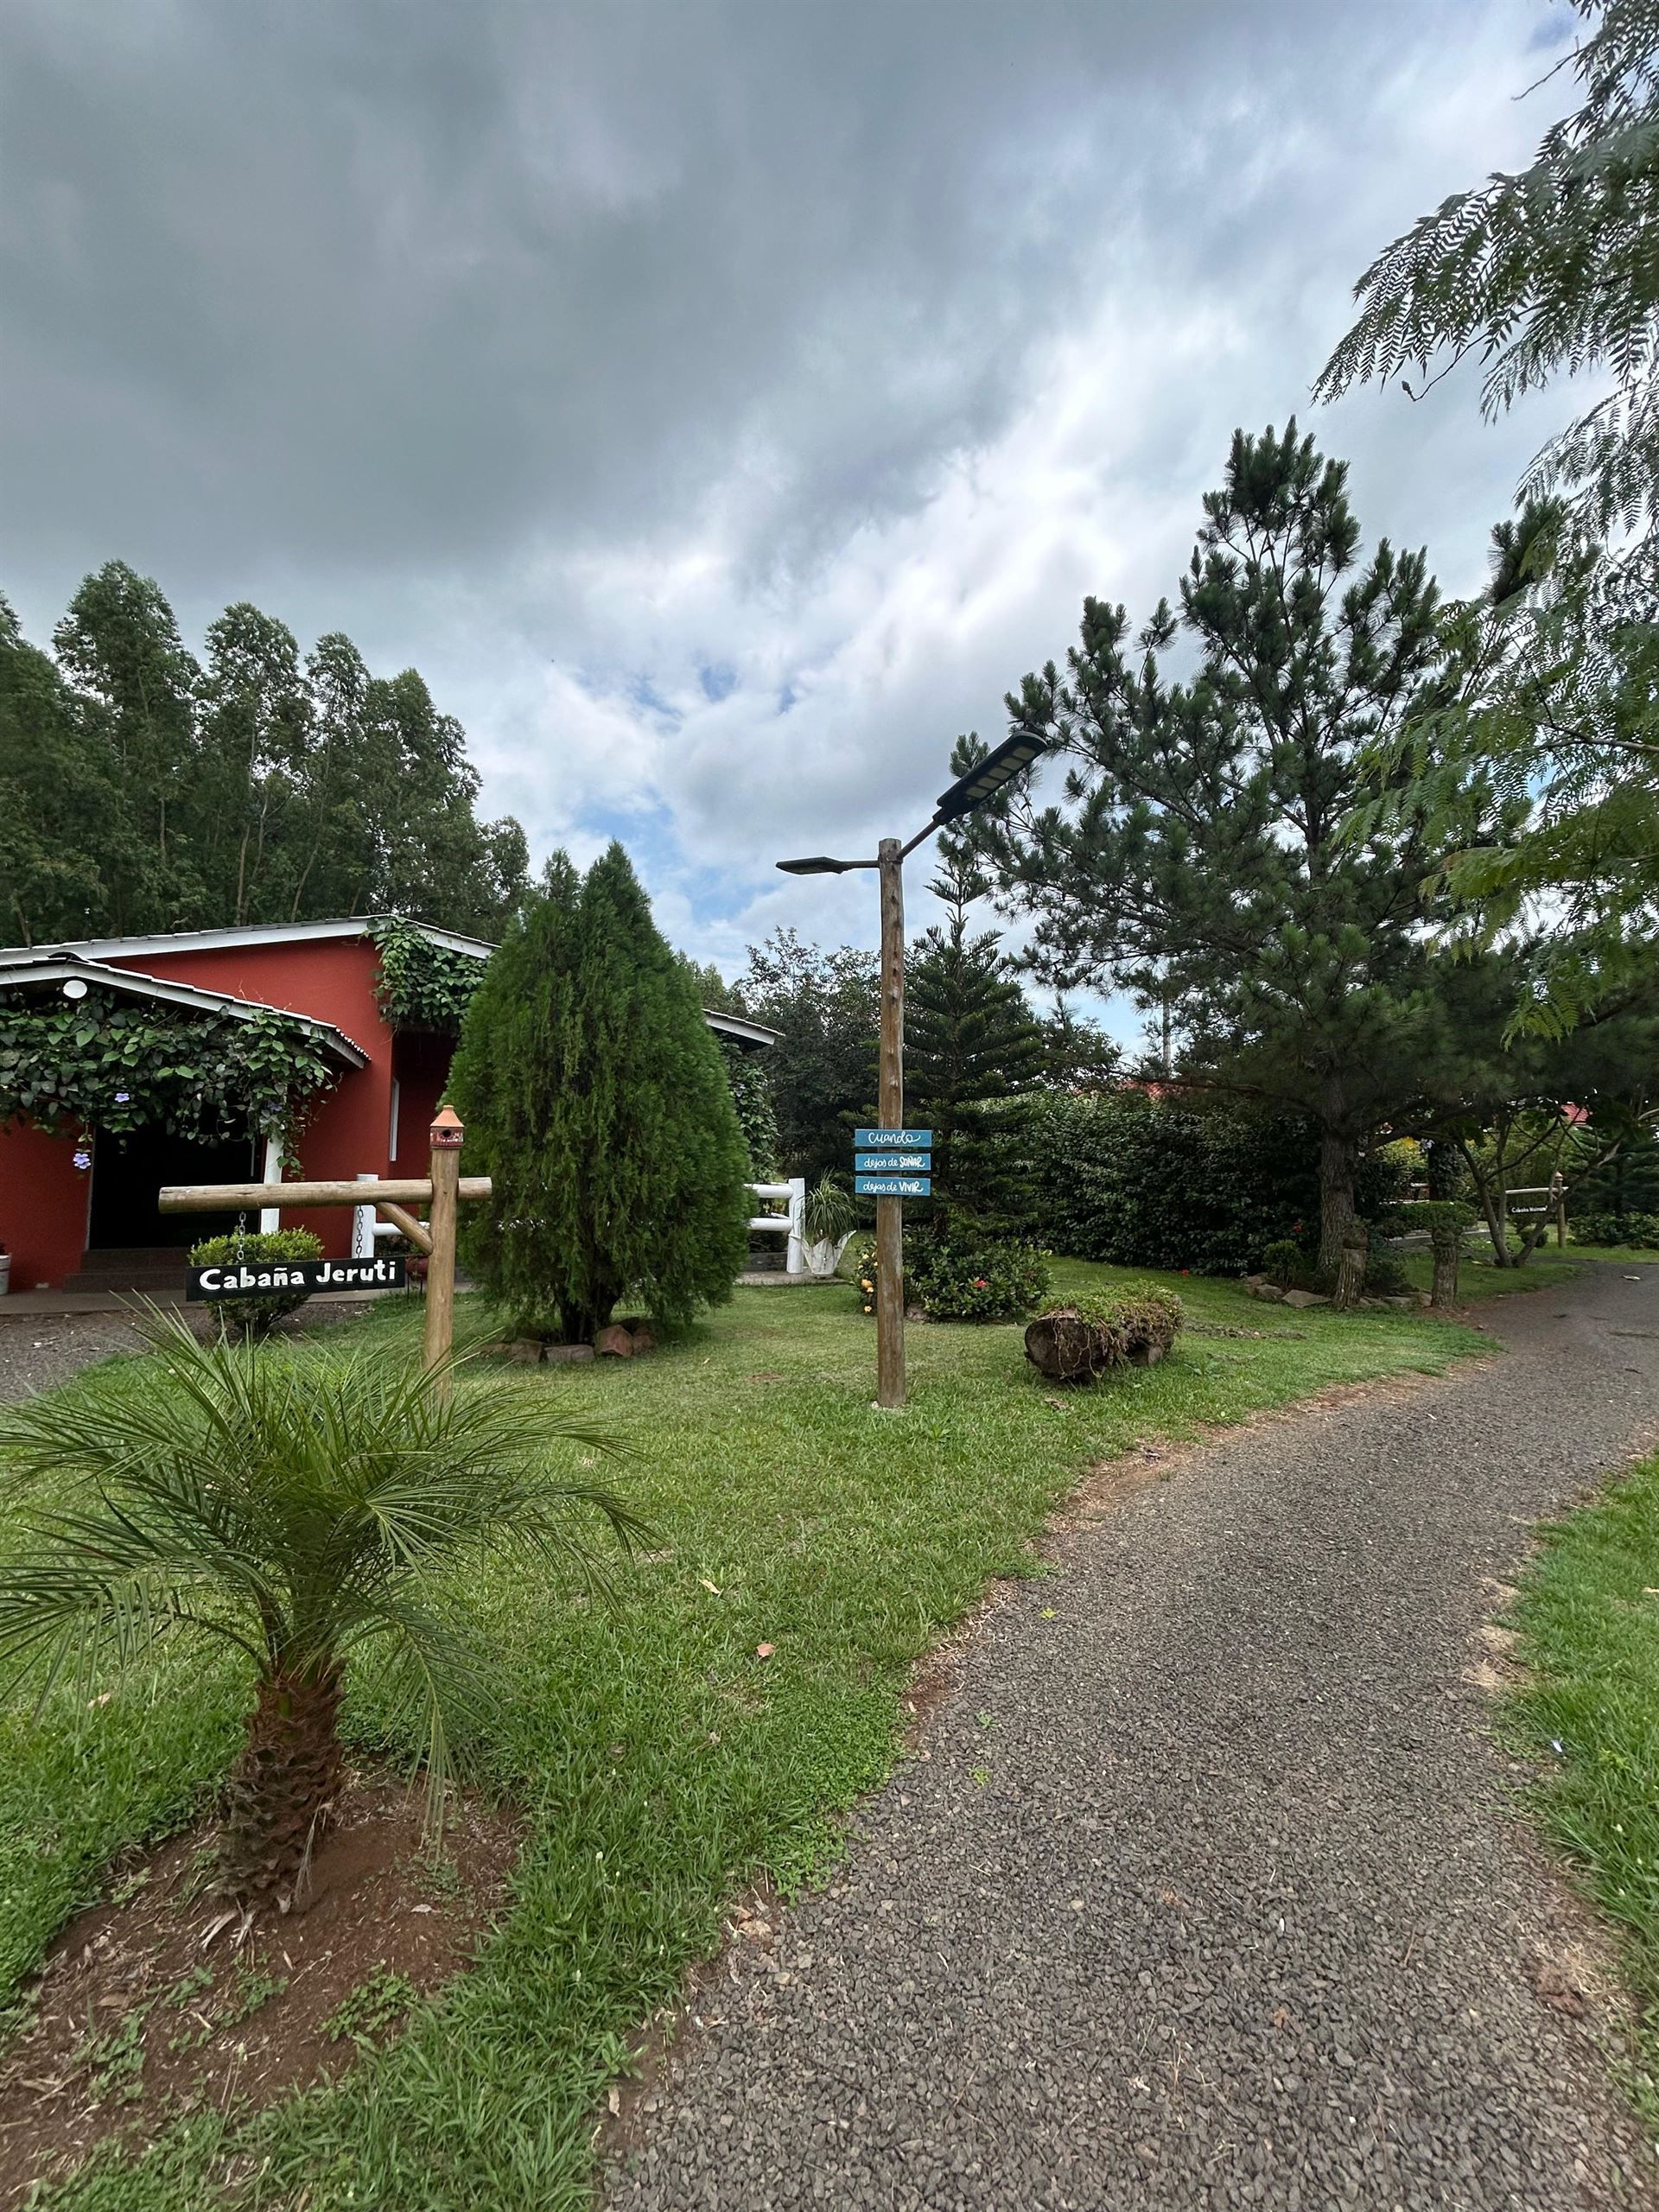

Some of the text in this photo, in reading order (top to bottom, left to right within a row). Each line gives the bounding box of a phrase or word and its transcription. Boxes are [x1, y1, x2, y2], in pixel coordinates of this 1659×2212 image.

[863, 1157, 887, 1168] dejas
[888, 1157, 899, 1167] de
[862, 1180, 924, 1193] dejas de VIVIR
[199, 1259, 397, 1291] Cabaña Jeruti
